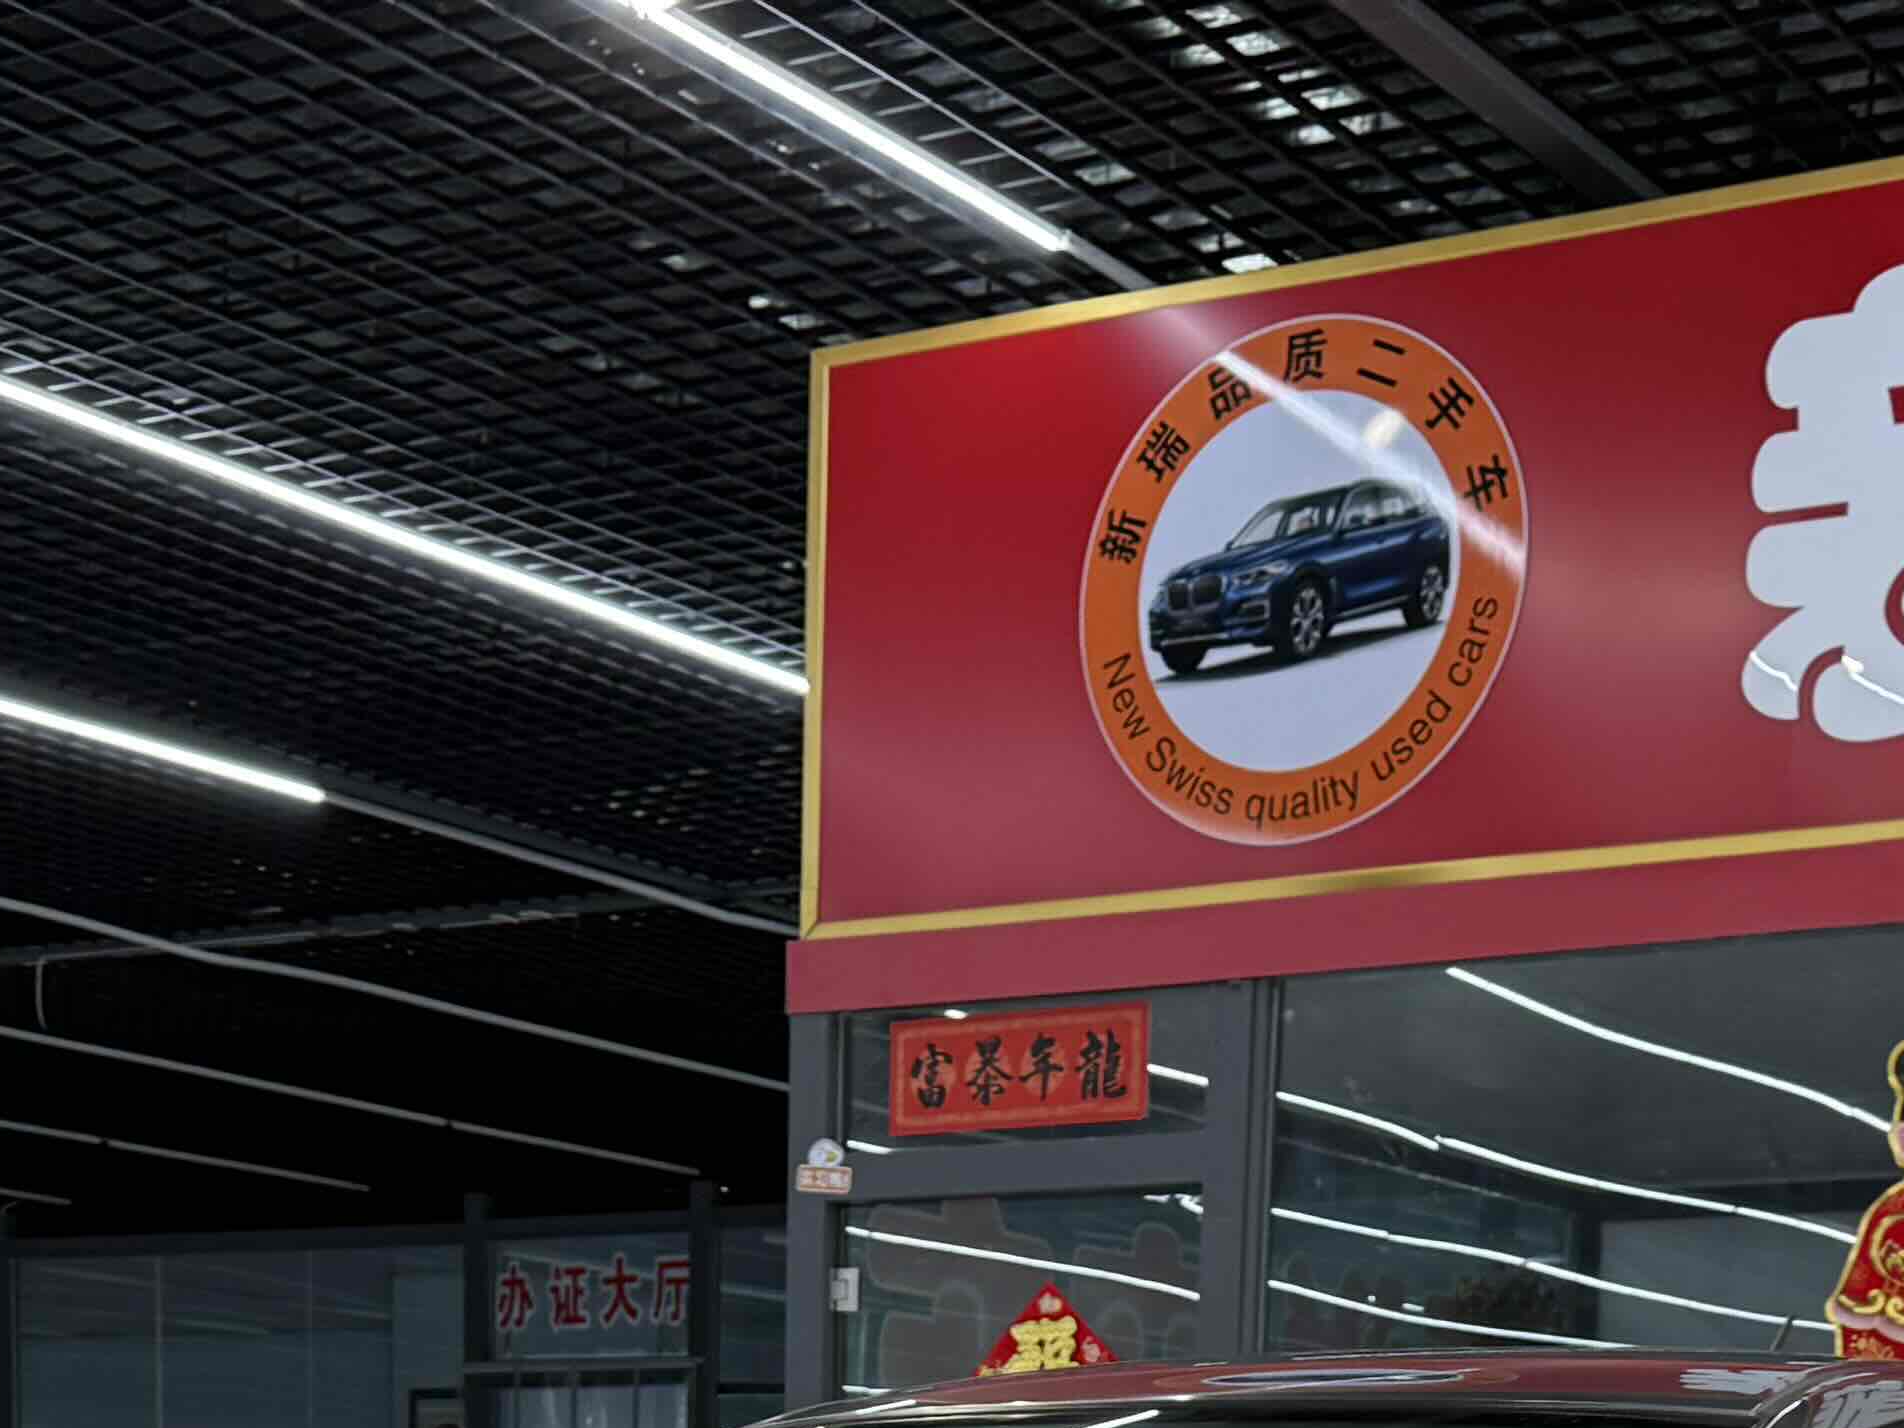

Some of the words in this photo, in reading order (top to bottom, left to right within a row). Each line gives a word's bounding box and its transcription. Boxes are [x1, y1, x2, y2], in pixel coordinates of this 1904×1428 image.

[1099, 328, 1511, 564] 新瑞品质二手车
[1103, 654, 1150, 742] New
[1145, 737, 1234, 816] Swiss
[1245, 770, 1361, 829] quality
[1370, 691, 1453, 783] used
[1447, 595, 1498, 688] cars
[496, 1251, 689, 1333] 办证大厅
